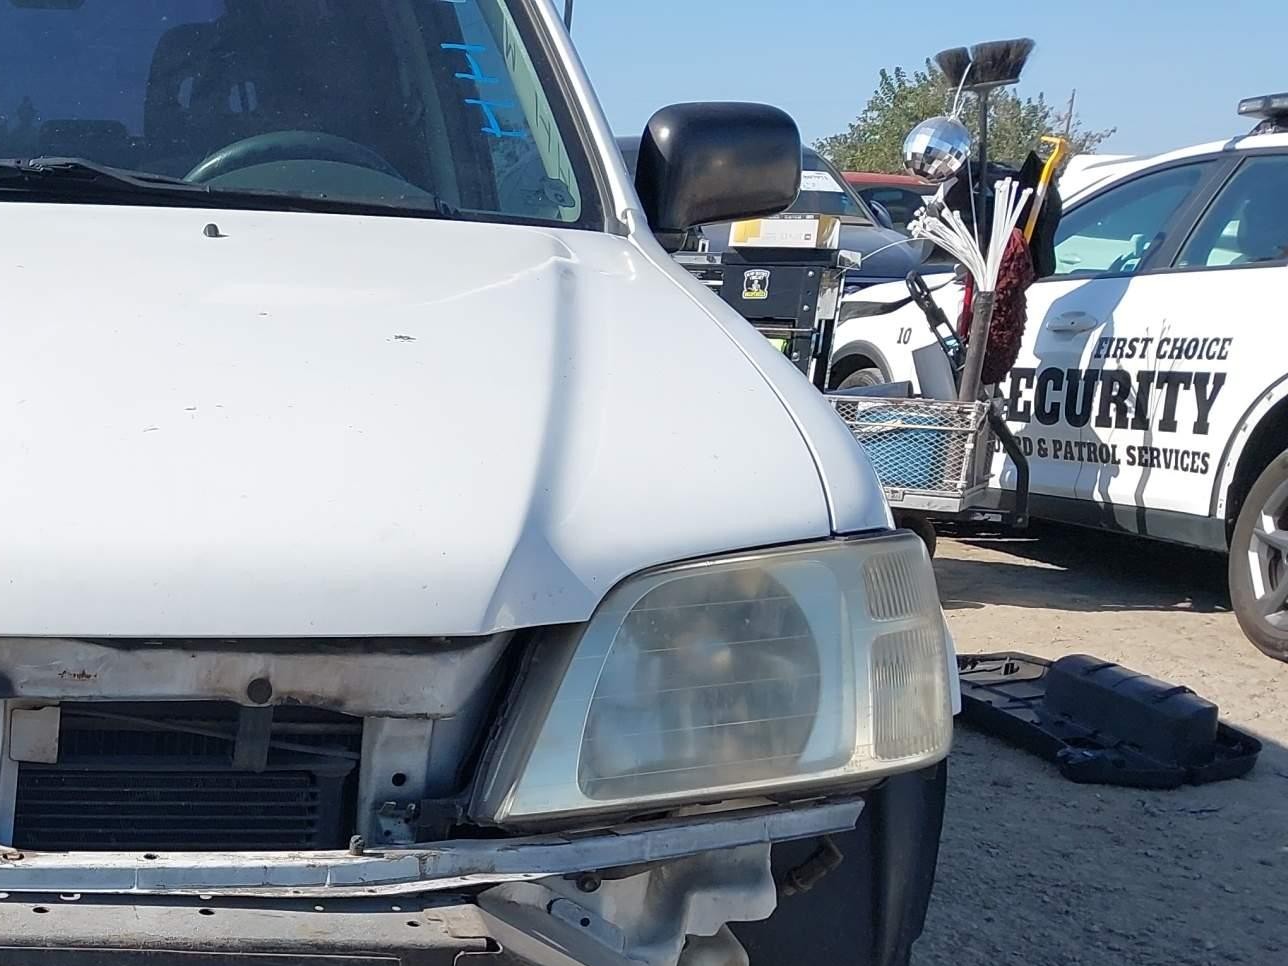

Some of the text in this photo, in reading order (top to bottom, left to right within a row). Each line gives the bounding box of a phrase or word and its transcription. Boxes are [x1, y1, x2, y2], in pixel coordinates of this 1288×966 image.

[896, 326, 913, 345] 10
[1093, 336, 1234, 361] FIRST CHOICE
[993, 367, 1227, 435] ECURITY
[1037, 437, 1049, 459] &
[1052, 439, 1122, 465] PATROL
[1126, 446, 1211, 475] SERVICES
